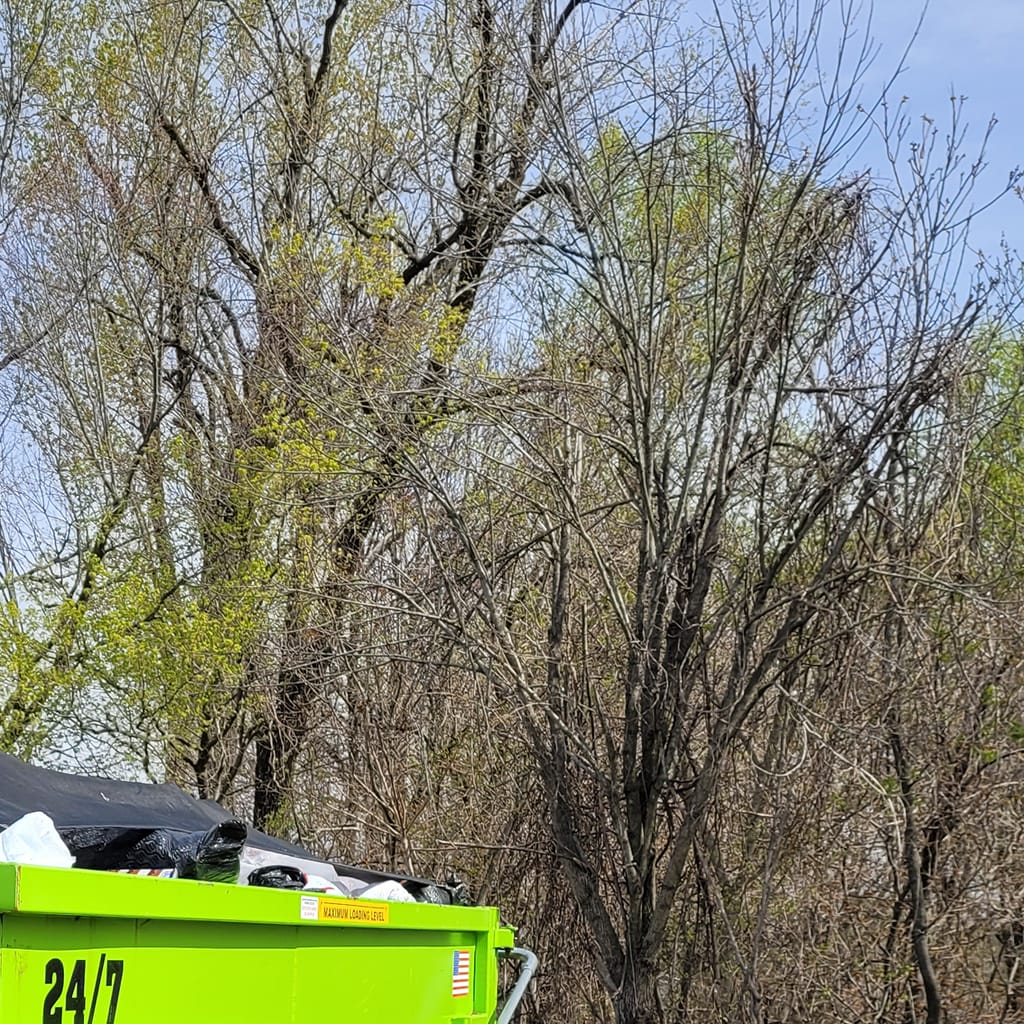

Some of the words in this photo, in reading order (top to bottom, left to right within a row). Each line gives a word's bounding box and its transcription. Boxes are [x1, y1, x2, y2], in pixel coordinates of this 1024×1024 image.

[323, 906, 349, 919] MAXIMUM
[349, 908, 370, 920] LOADING
[370, 910, 385, 922] LEVEL
